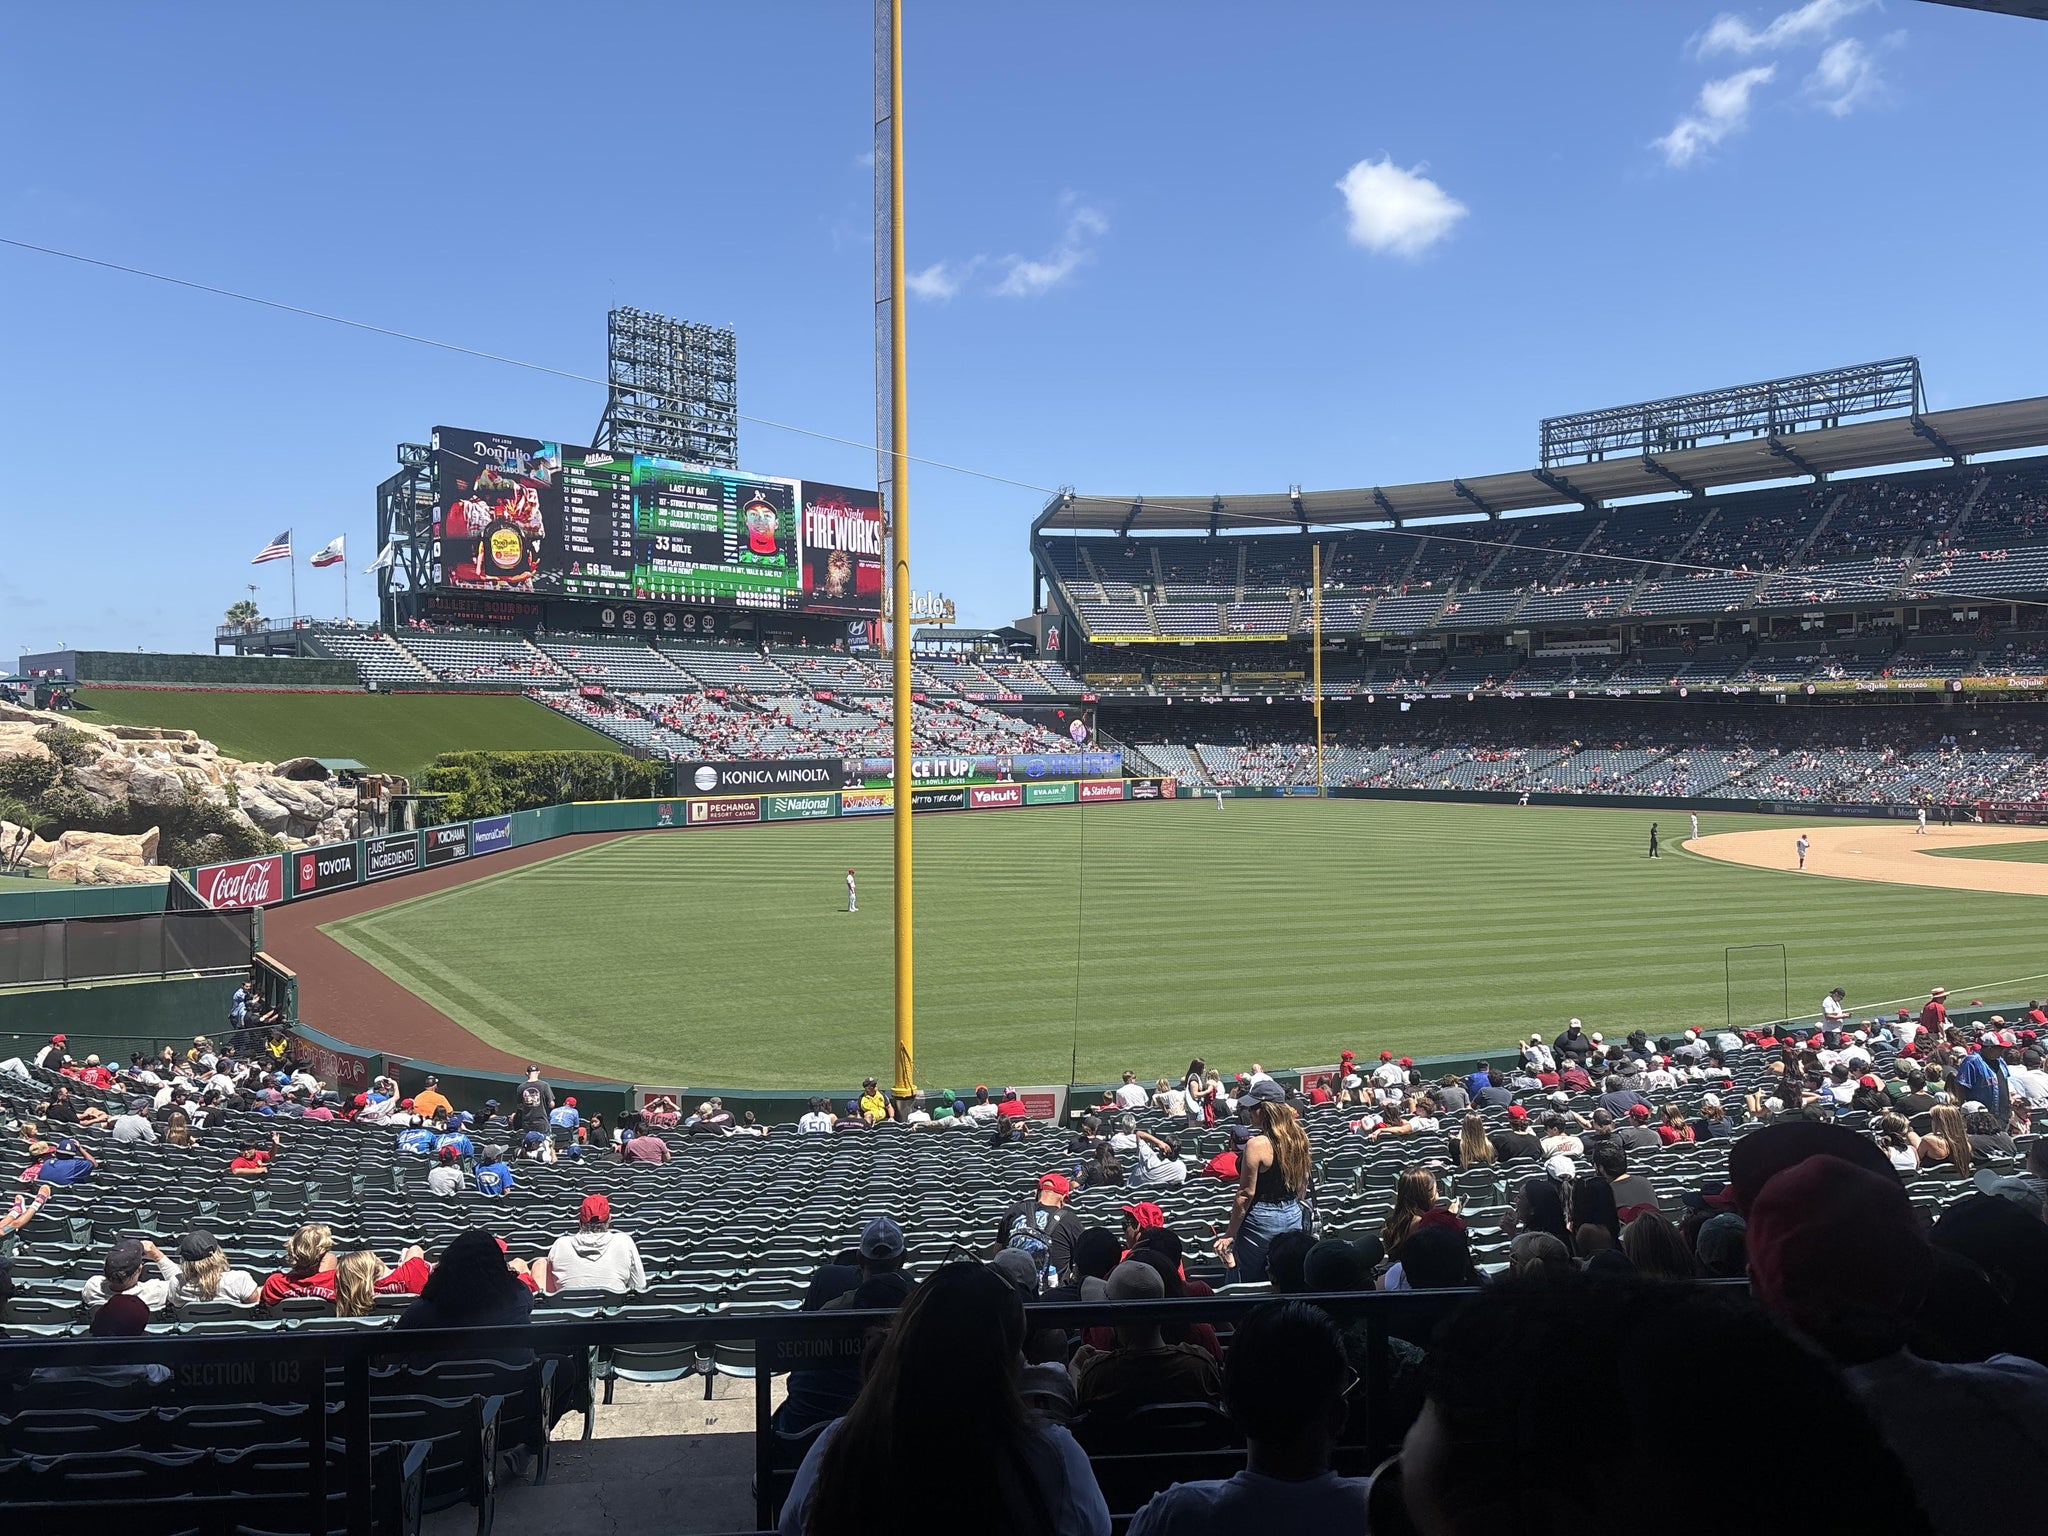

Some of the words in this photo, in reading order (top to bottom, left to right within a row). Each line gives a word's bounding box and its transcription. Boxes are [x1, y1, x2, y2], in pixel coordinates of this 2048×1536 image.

[669, 484, 684, 493] LAST
[687, 486, 695, 494] AT
[696, 487, 708, 496] BAT
[670, 499, 688, 508] STRUCK
[684, 511, 693, 519] OUT
[806, 502, 842, 520] Saturday
[843, 508, 865, 522] Night
[805, 512, 881, 556] FIREWORKS
[656, 536, 670, 550] 33
[672, 543, 692, 554] BOLTE
[587, 562, 599, 576] 56
[653, 558, 664, 566] FIRST
[666, 560, 684, 568] PLAYER
[700, 563, 718, 571] HISTORY
[746, 568, 759, 576] WALK
[764, 569, 774, 577] SAC
[605, 611, 612, 622] 11
[625, 613, 635, 622] 26
[645, 614, 655, 624] 29
[665, 615, 675, 625] 30
[685, 616, 695, 626] 42
[704, 617, 713, 627] 50
[934, 759, 948, 777] IT
[722, 770, 773, 785] KONICA
[777, 768, 831, 783] MINOLTA
[846, 794, 882, 810] Surfside
[974, 790, 1019, 803] Yakult
[711, 803, 755, 813] PECHANGA
[787, 797, 830, 811] National
[1897, 808, 1919, 817] Model
[437, 828, 466, 845] YOKOHAMA
[475, 828, 505, 843] MemorialCare
[371, 840, 386, 855] JUST
[453, 845, 465, 857] TIRES
[372, 848, 414, 870] INGREDIENTS
[318, 857, 352, 877] TOYOTA
[209, 861, 273, 908] Coca-Cola
[777, 1339, 833, 1358] SECTION
[838, 1337, 861, 1356] 103
[180, 1360, 256, 1386] SECTION
[270, 1359, 300, 1384] 103
